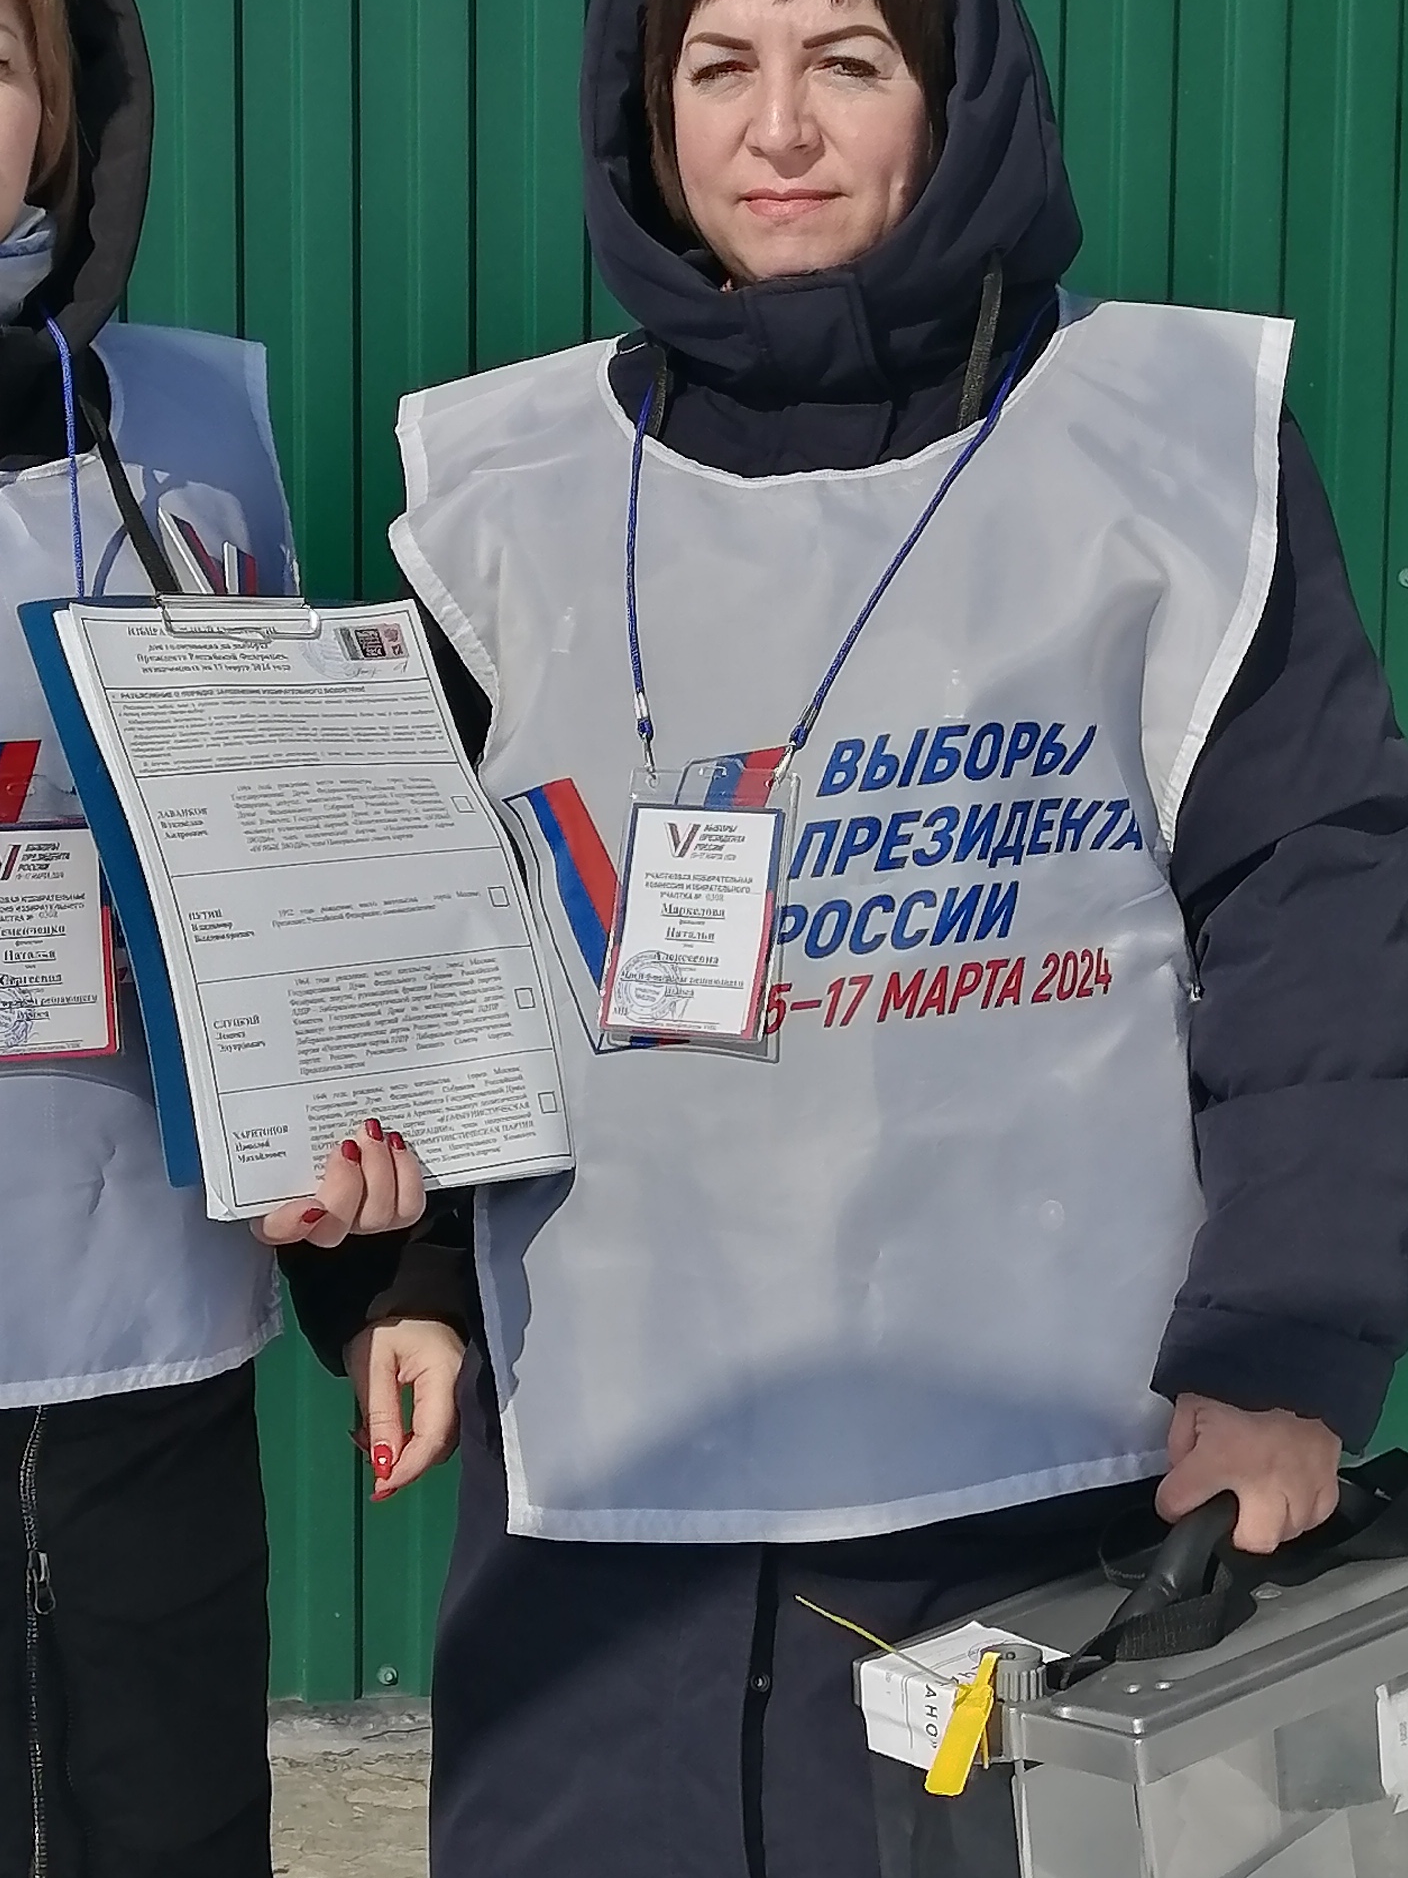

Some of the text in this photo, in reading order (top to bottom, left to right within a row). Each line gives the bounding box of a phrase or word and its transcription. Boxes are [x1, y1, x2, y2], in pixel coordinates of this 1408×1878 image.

[817, 722, 1097, 797] ВЫБОРЫ
[788, 798, 1144, 880] ПРЕЗИДЕНТА
[777, 881, 1019, 959] РОССИИ
[766, 948, 1112, 1035] 5–17 МАРТА 2024
